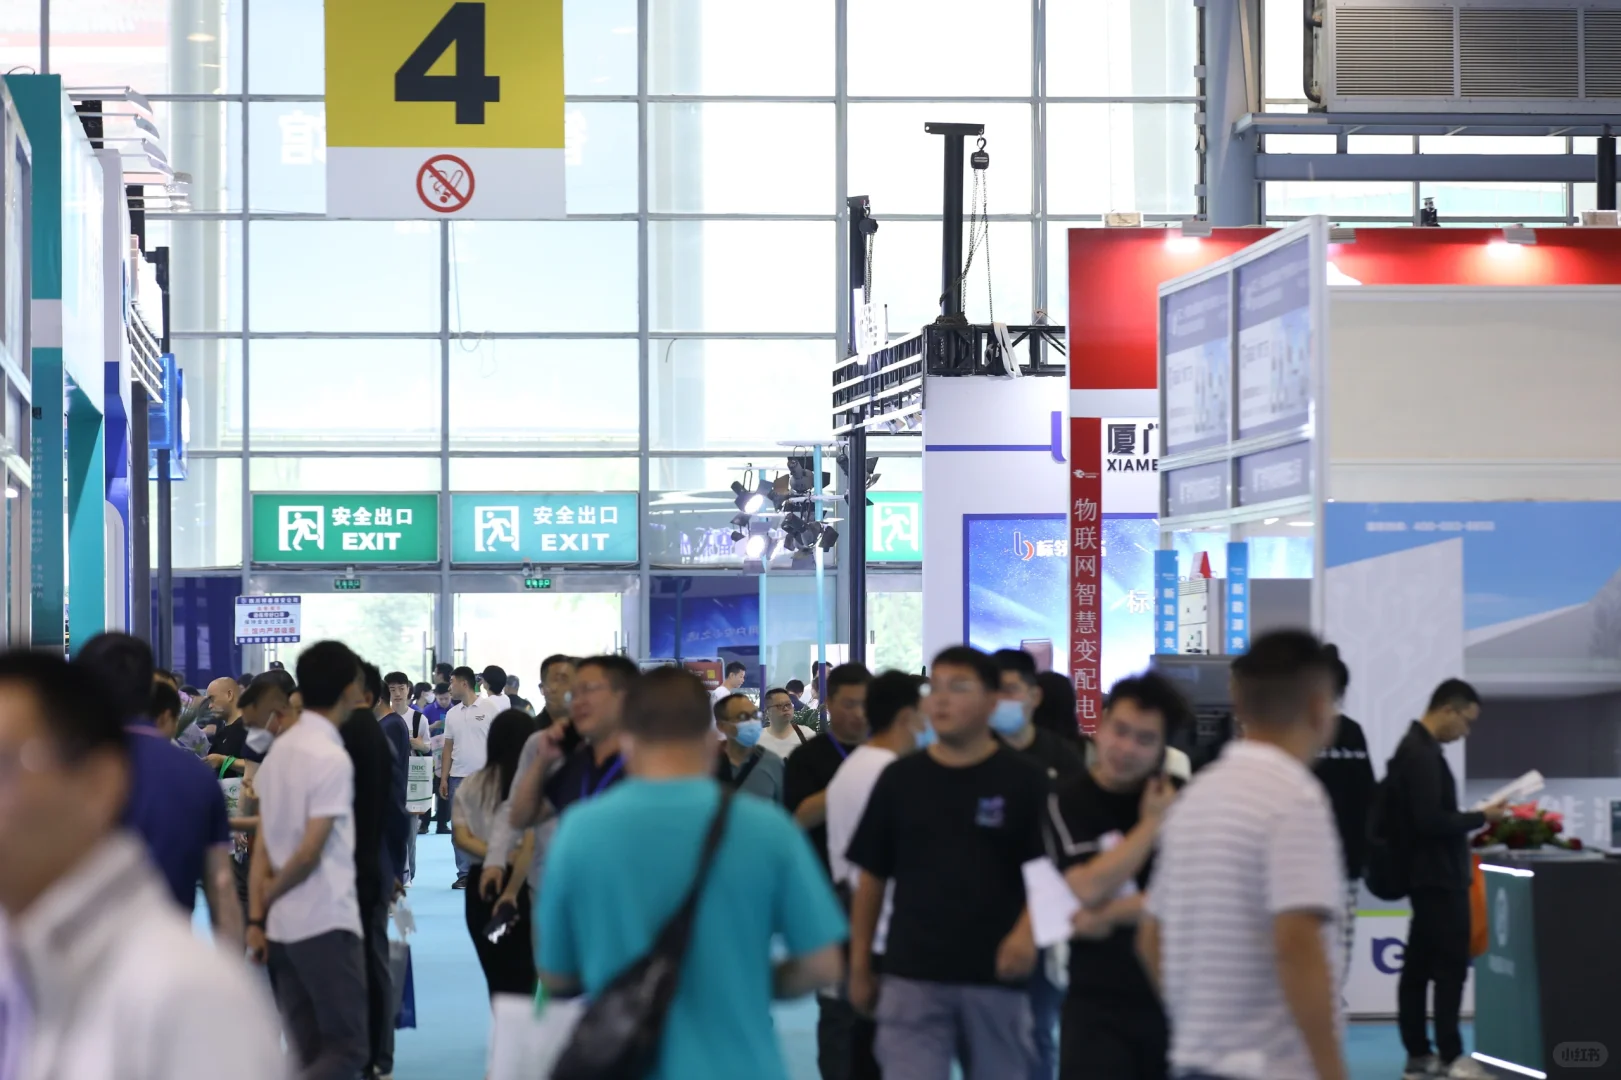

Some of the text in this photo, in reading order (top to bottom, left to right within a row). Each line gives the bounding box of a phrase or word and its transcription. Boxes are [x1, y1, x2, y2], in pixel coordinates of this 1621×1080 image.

[394, 2, 501, 126] 4
[331, 506, 413, 526] 安全出口
[533, 504, 619, 526] 安全出口
[342, 532, 402, 551] EXIT
[541, 532, 610, 552] EXIT
[1126, 589, 1155, 614] 标
